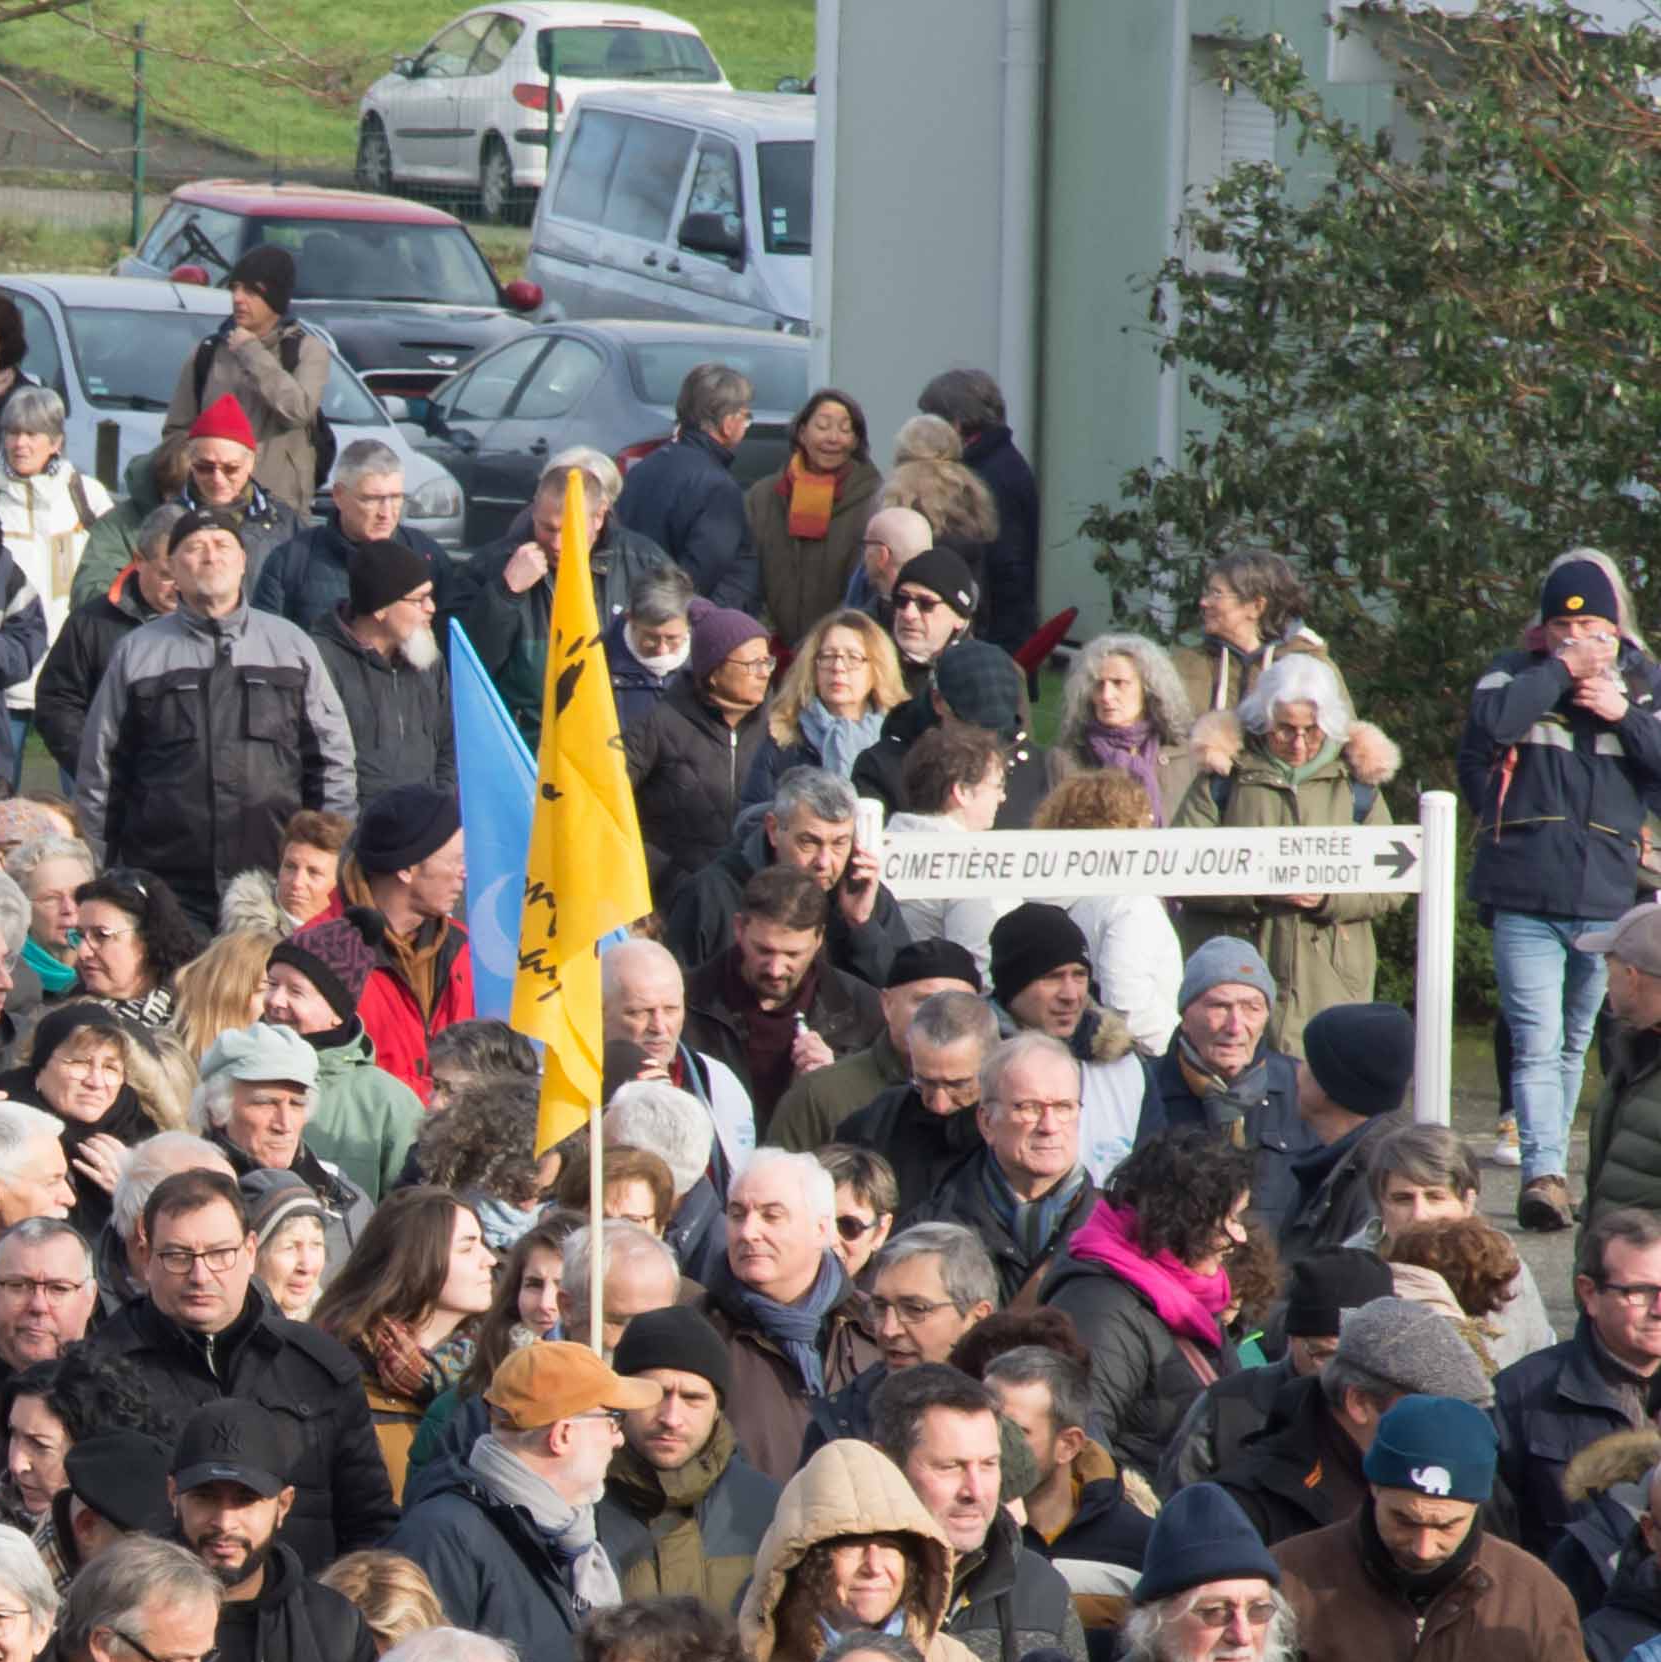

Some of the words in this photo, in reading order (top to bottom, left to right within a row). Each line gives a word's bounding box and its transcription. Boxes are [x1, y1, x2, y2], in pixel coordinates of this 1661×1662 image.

[1279, 831, 1352, 856] ENTRÉE
[885, 847, 1014, 880] CIMETIÈRE
[1023, 849, 1058, 878] DU
[1064, 849, 1140, 877] POINT
[1143, 848, 1179, 875] DU
[1269, 866, 1300, 885] IMP
[1306, 865, 1362, 884] DIDOT
